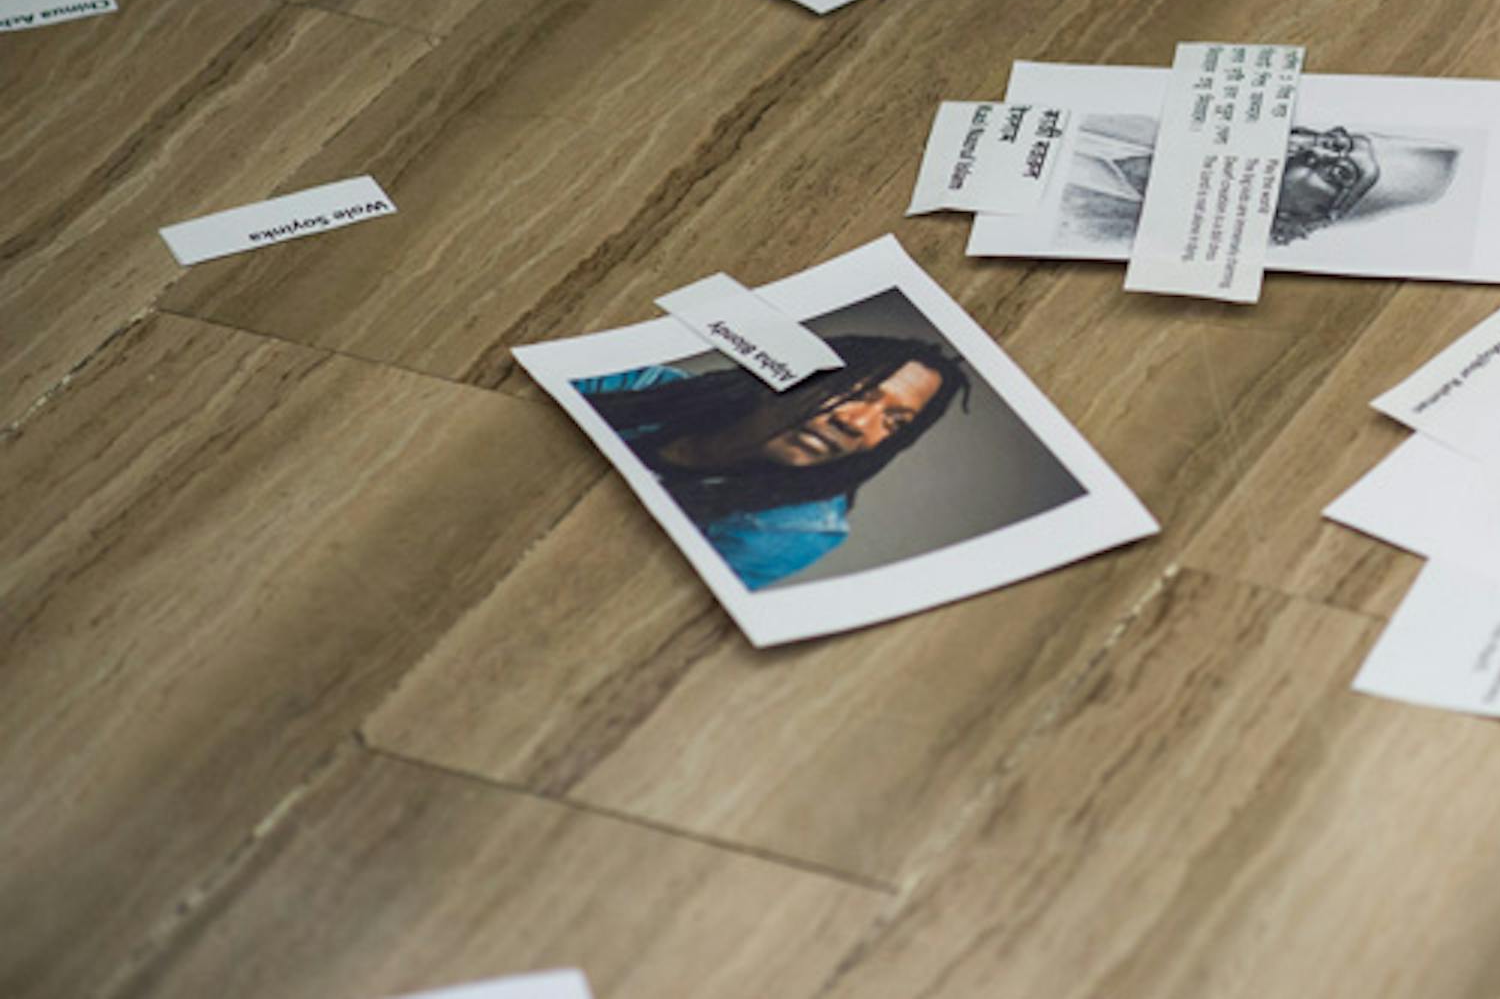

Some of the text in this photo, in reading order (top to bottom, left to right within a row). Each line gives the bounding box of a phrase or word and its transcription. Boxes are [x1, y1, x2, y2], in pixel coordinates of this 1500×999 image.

[41, 0, 110, 19] Chinua
[249, 200, 389, 242] Wole Soyinka
[707, 320, 798, 382] Alpha Blondy
